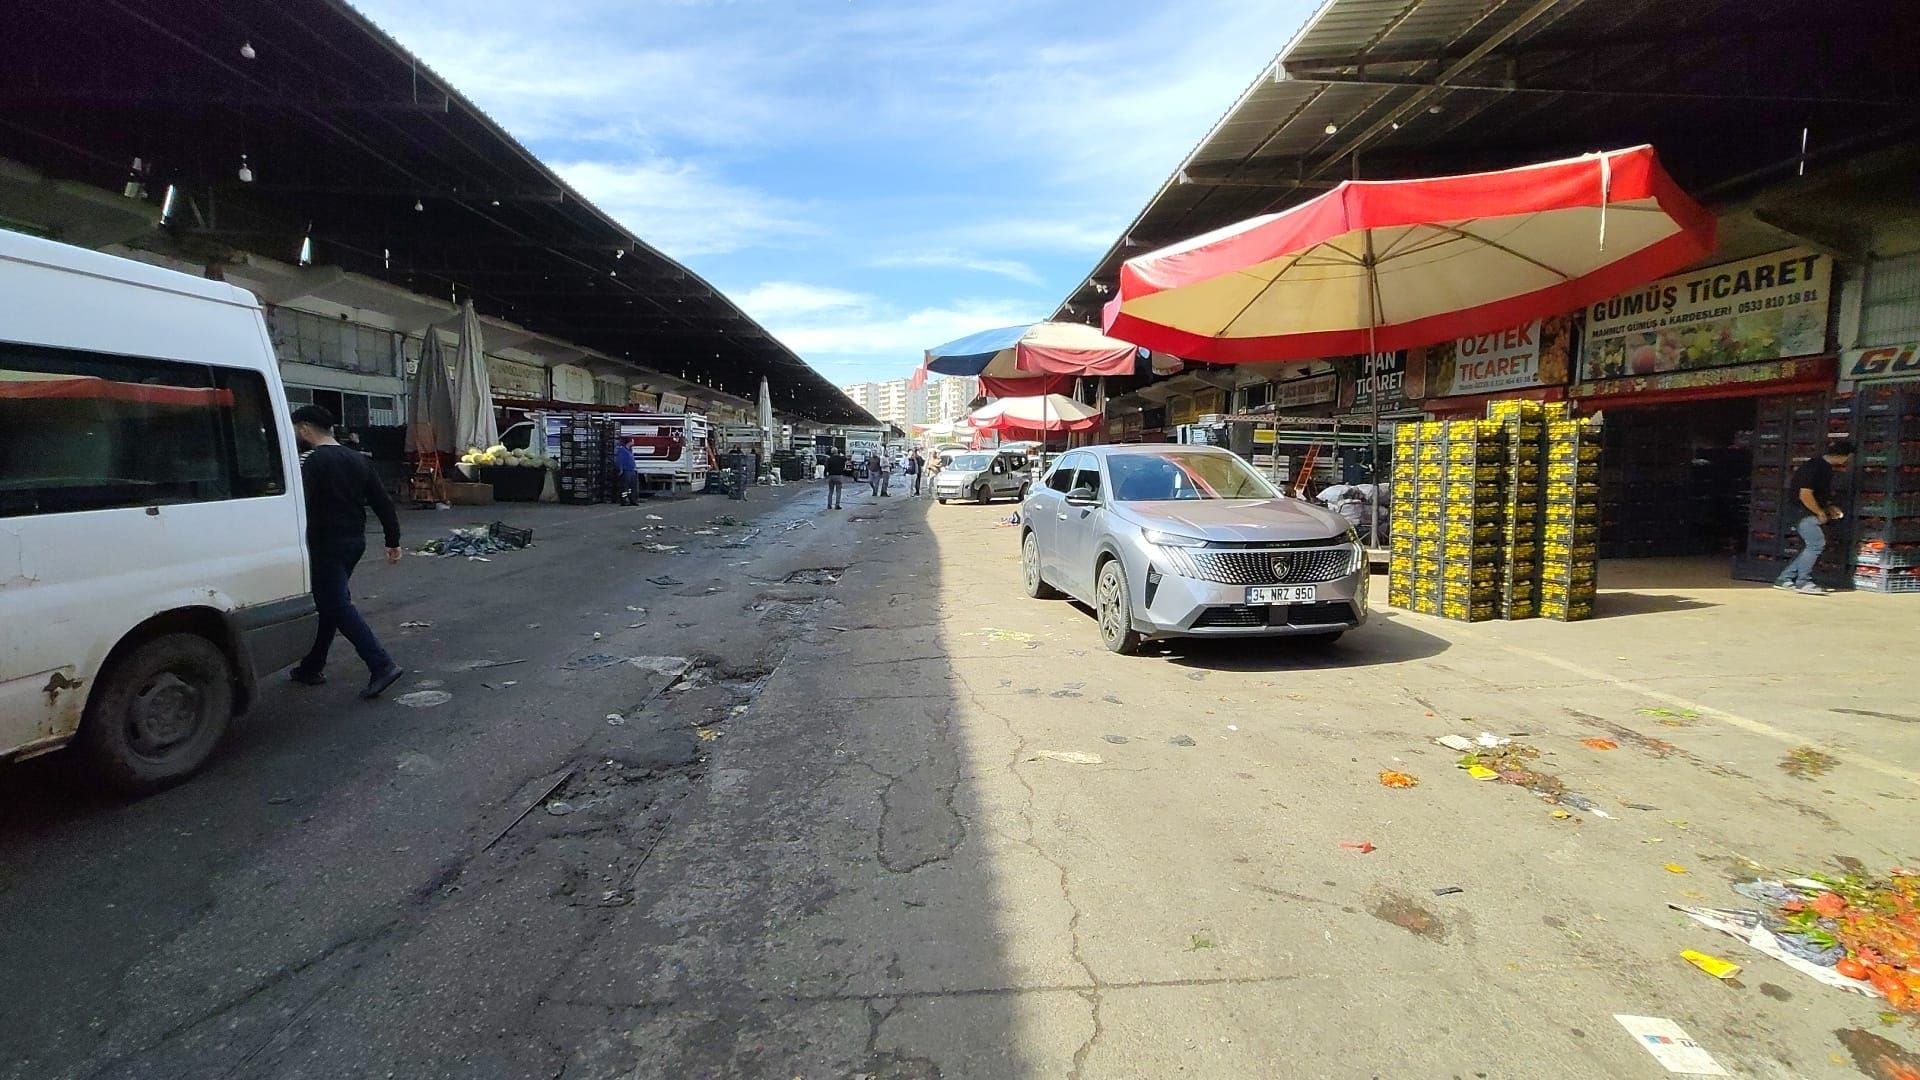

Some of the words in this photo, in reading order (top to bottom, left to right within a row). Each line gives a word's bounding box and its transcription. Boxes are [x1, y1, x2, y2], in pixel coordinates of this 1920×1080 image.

[1592, 325, 1625, 338] MAHMUT
[1738, 300, 1763, 314] 0533
[1593, 284, 1677, 322] GÜMÜŞ
[1253, 589, 1265, 601] 34
[1271, 588, 1289, 601] NRZ
[1295, 587, 1314, 600] 950
